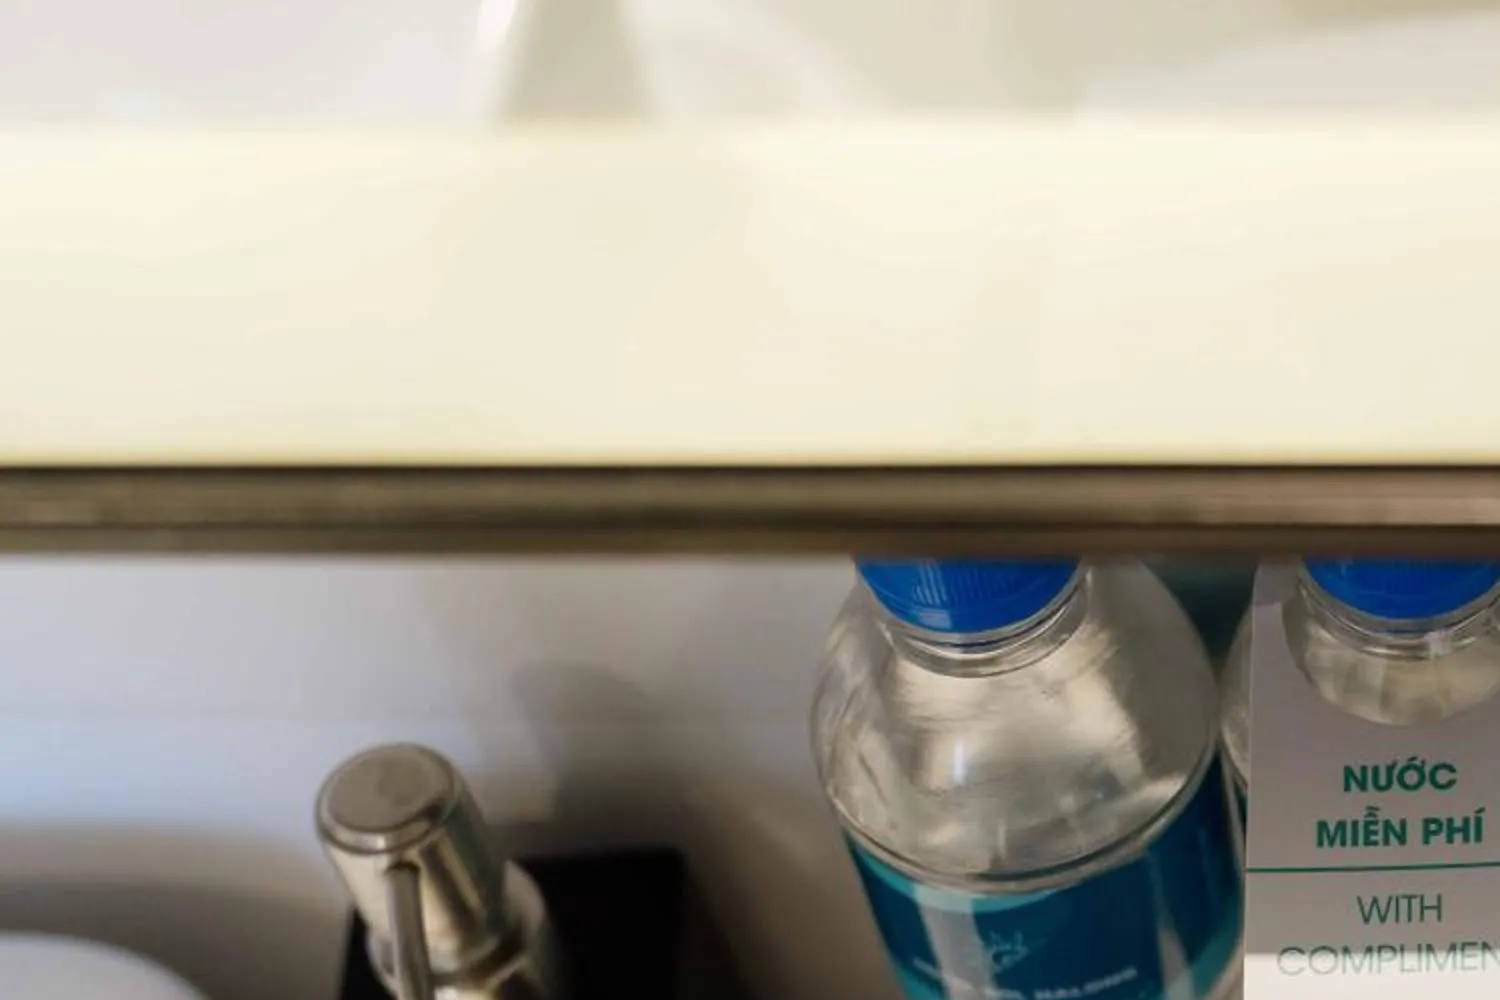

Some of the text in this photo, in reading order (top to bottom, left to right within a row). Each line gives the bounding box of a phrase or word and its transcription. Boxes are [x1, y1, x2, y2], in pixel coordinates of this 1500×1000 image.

[1342, 755, 1458, 793] NƯỚC
[1316, 806, 1486, 848] MIỄN PHÍ
[1357, 893, 1443, 925] WITH
